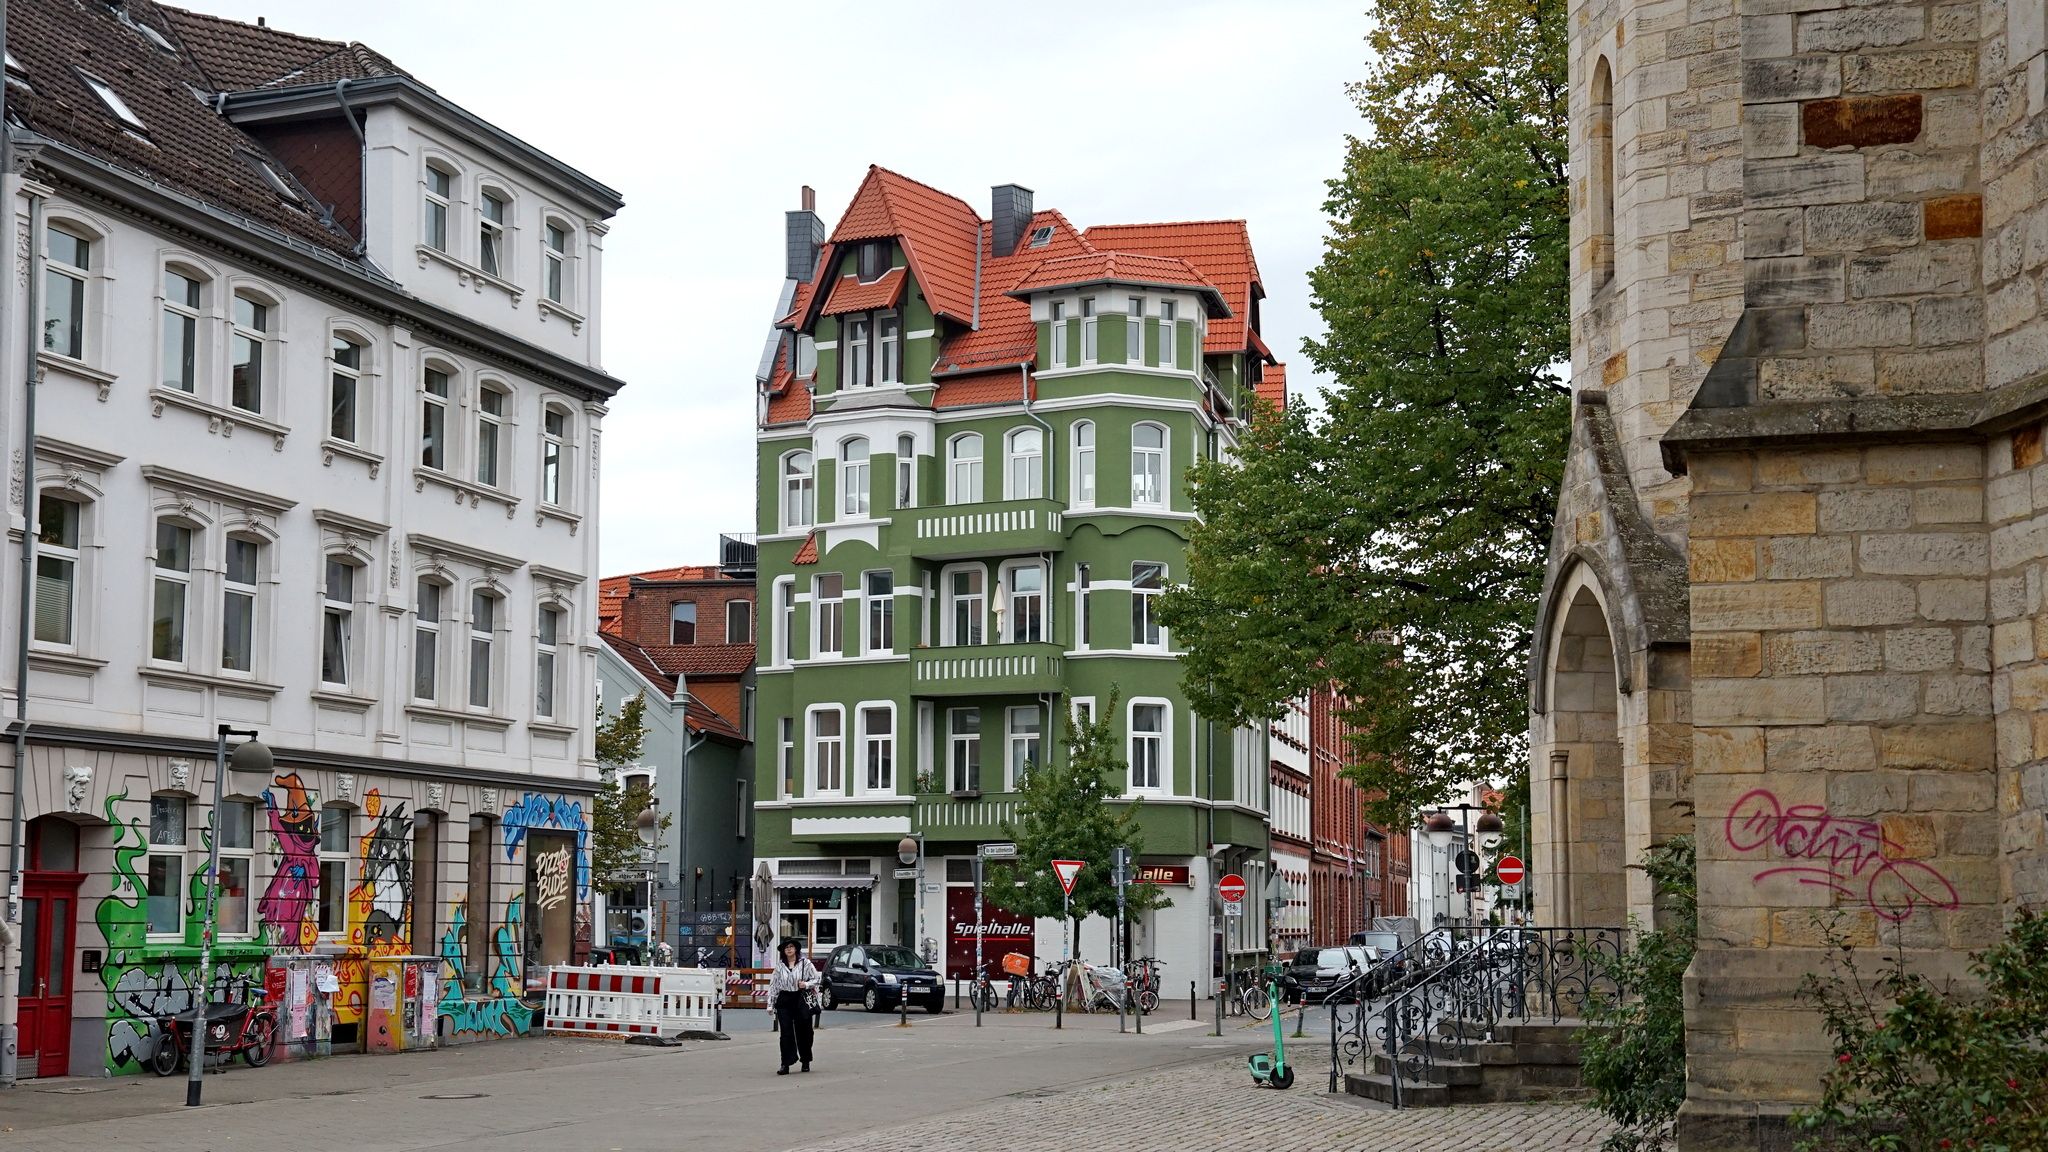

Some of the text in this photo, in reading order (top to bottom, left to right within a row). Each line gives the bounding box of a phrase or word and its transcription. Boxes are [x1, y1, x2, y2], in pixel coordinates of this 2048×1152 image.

[123, 881, 132, 892] 10
[537, 873, 569, 905] BUDE
[954, 922, 1031, 936] Spielhalle
